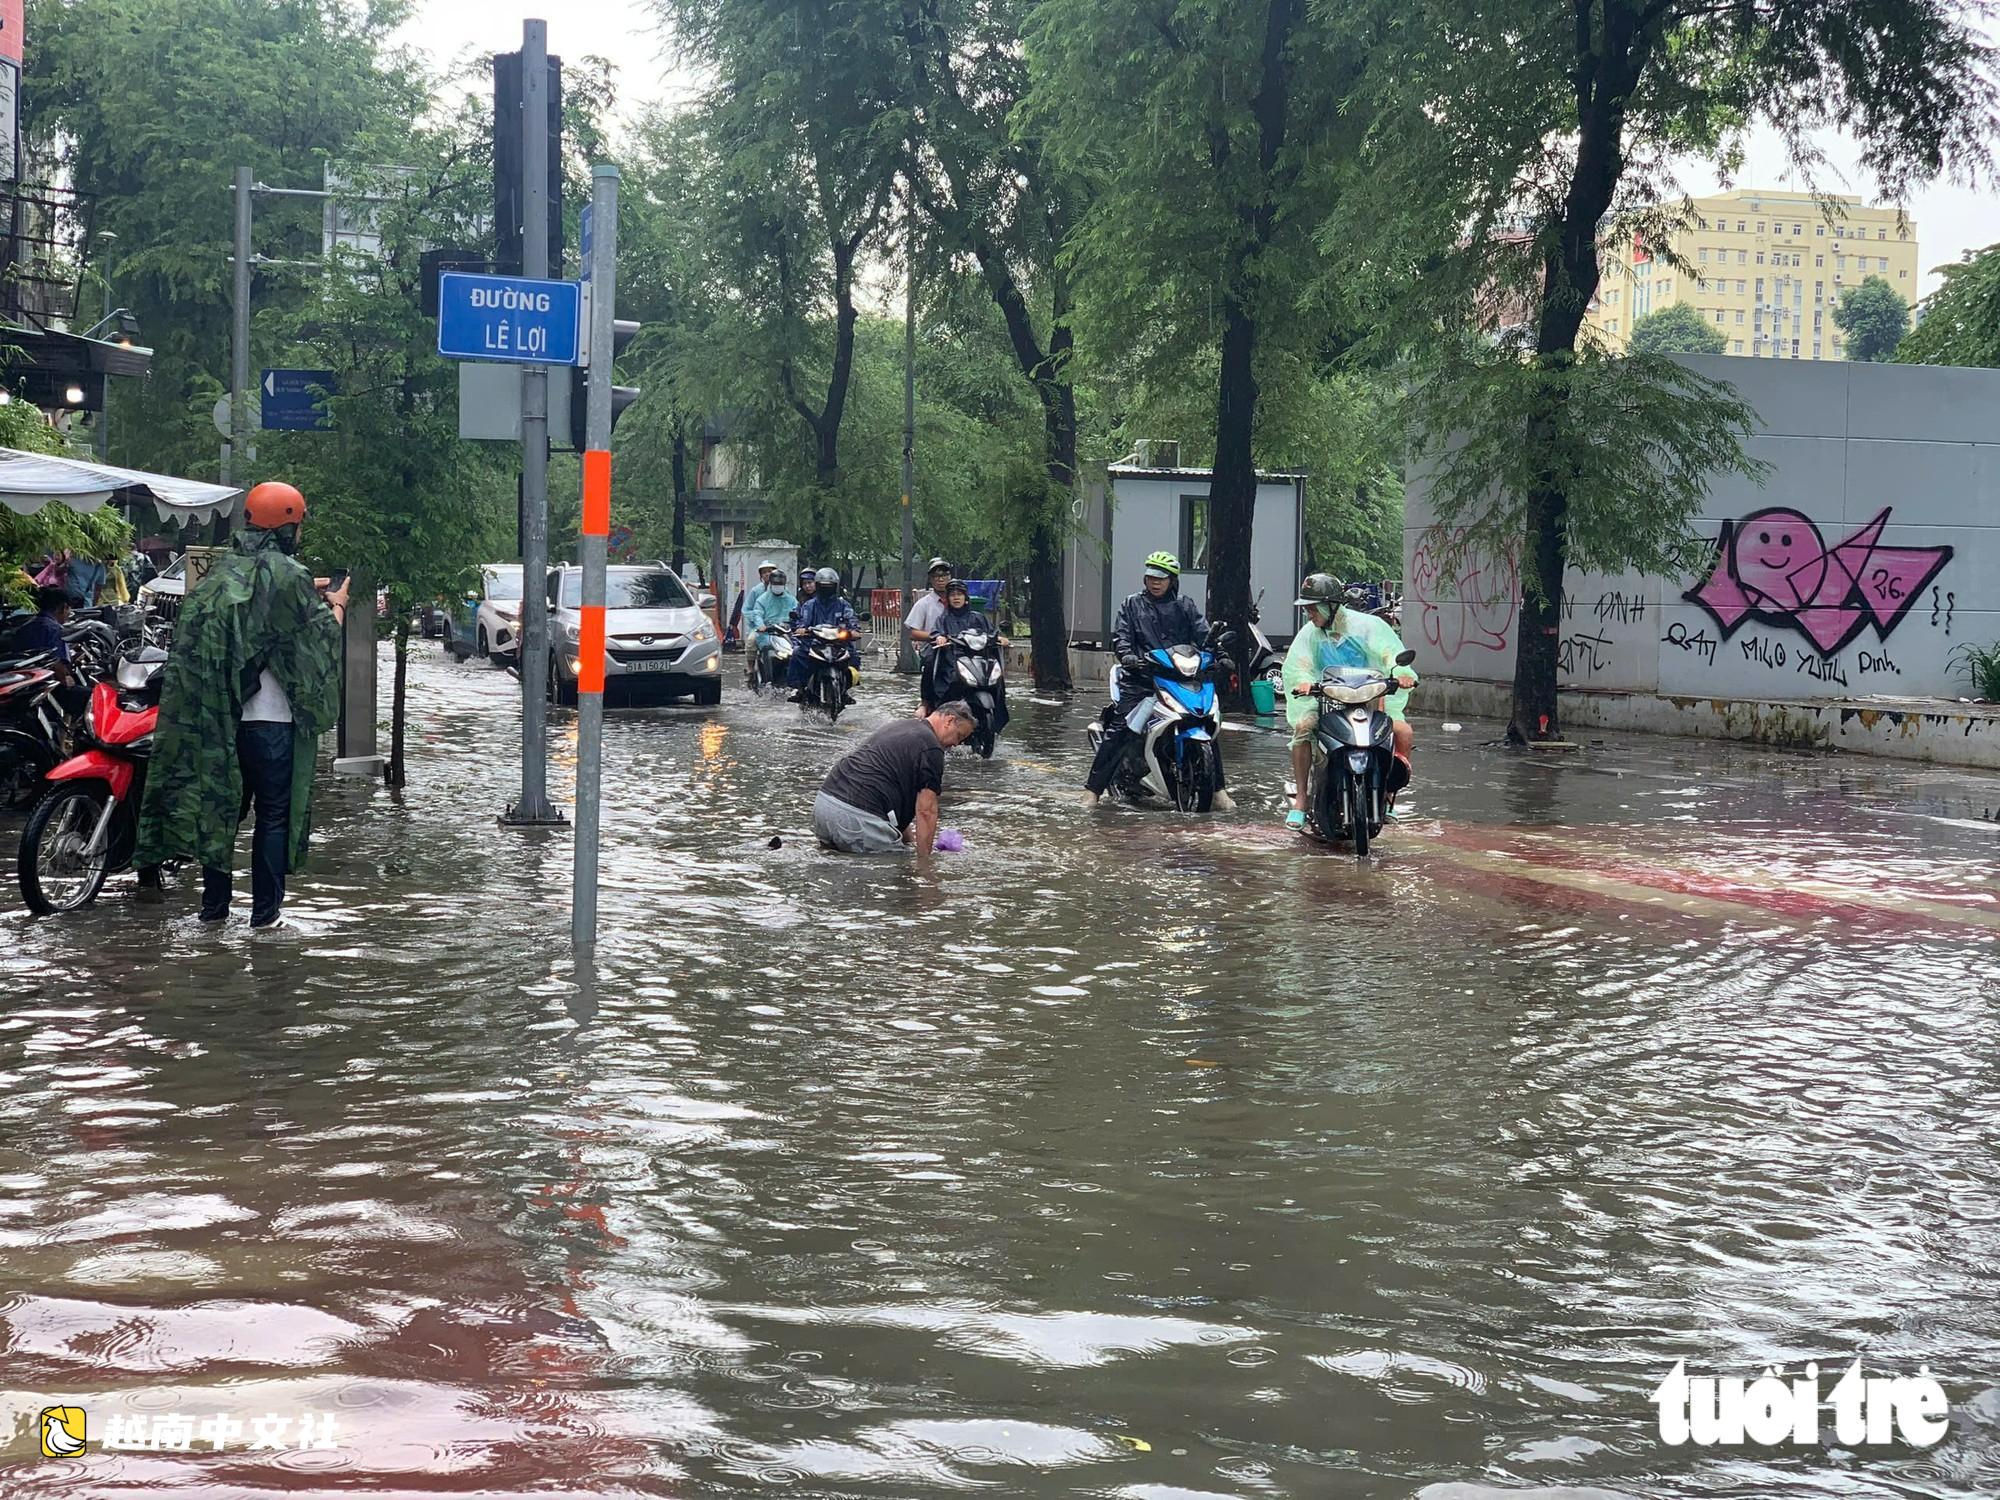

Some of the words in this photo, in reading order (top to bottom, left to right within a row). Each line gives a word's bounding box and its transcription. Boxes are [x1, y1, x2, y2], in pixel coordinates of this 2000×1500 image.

[470, 286, 550, 312] ĐƯỜNG
[485, 319, 510, 350] LÊ
[517, 325, 546, 357] LỢI
